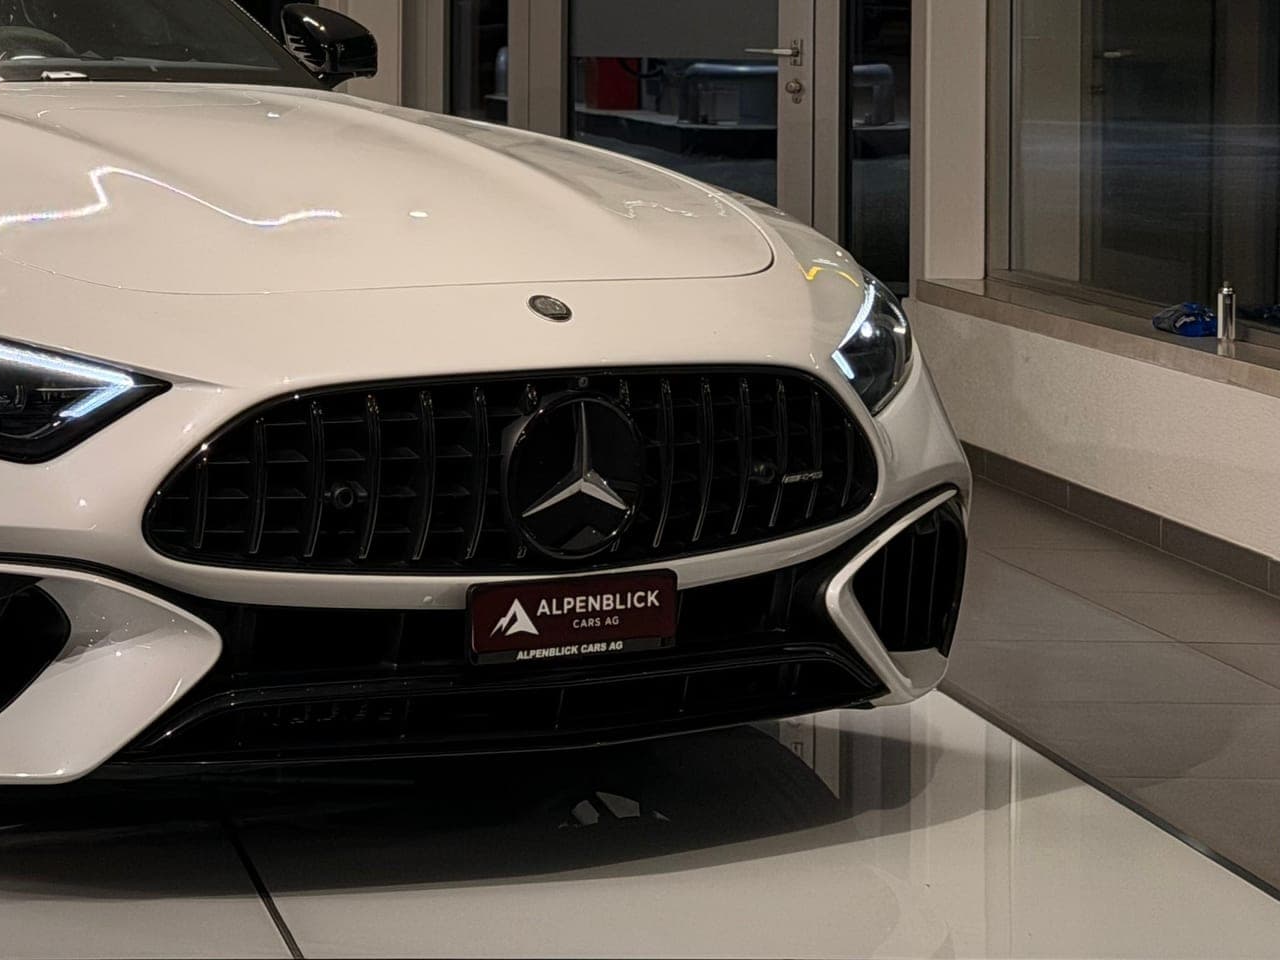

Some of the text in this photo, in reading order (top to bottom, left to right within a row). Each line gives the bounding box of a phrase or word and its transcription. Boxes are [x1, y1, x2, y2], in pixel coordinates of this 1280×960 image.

[536, 589, 661, 617] ALPENBLICK
[572, 615, 620, 629] CARS AG
[516, 640, 624, 660] ALPENBLICK CARS AG
